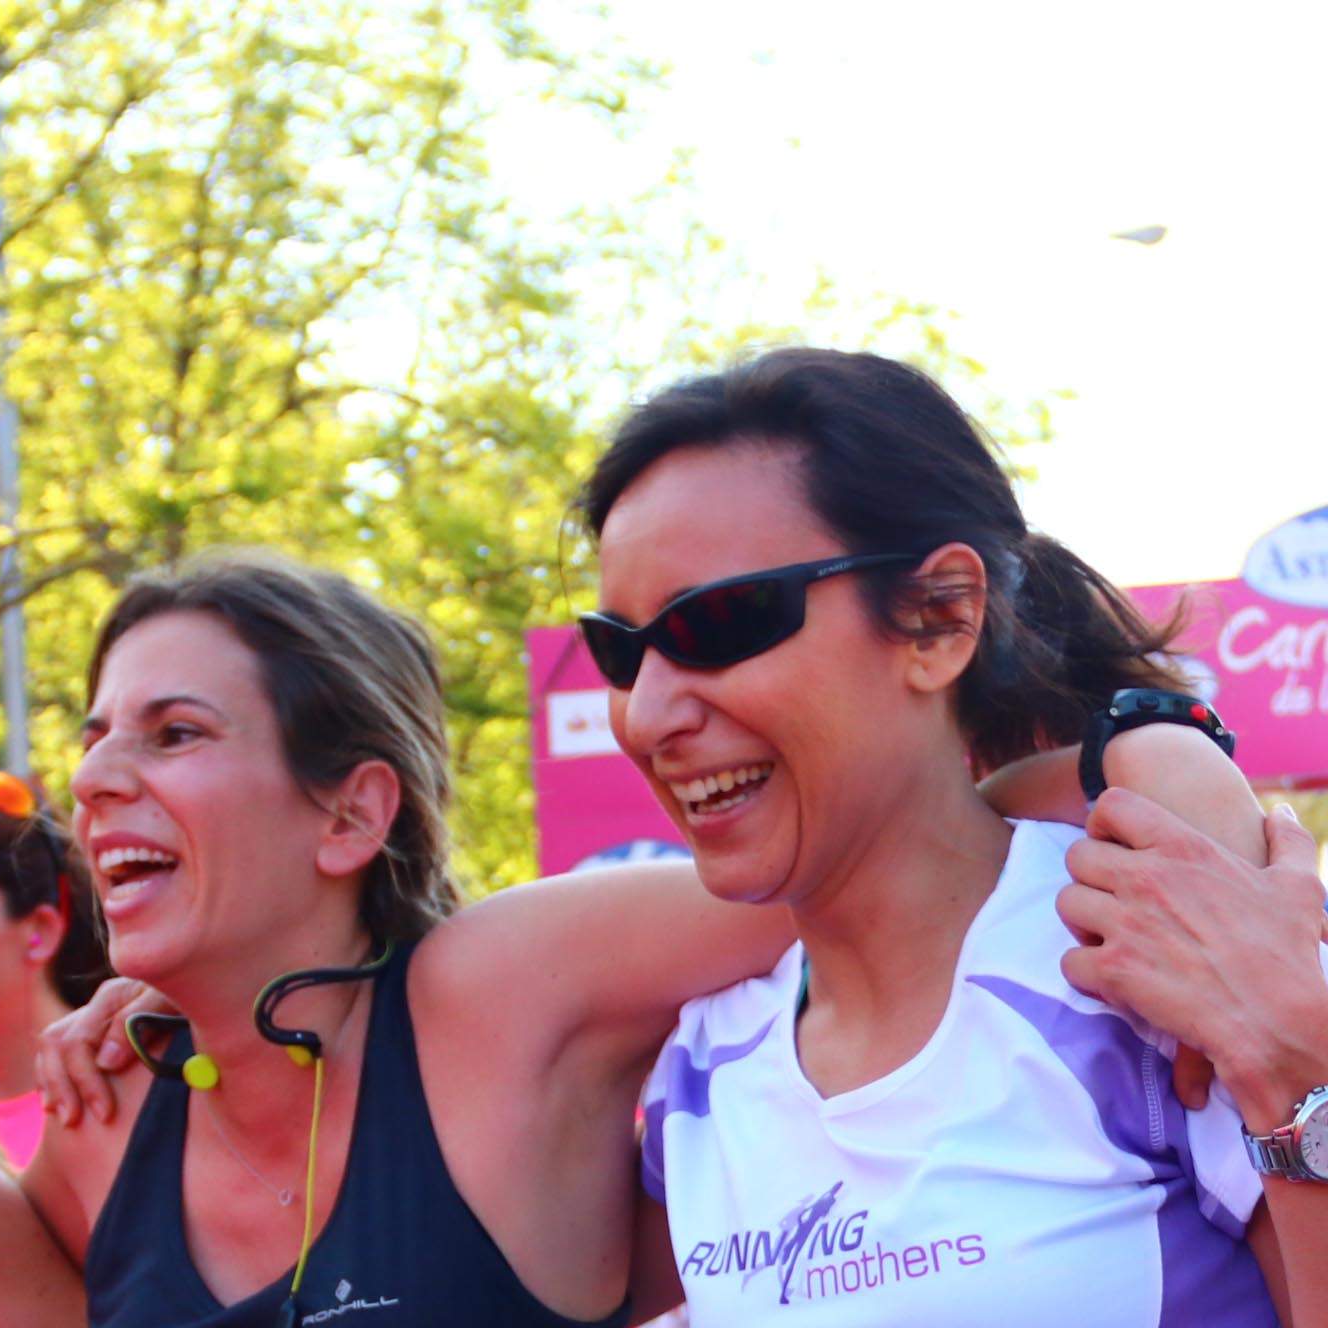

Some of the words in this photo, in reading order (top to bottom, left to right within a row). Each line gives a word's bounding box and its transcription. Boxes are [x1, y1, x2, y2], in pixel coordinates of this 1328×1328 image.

[1272, 671, 1315, 714] de
[806, 1234, 987, 1300] mothers
[301, 1296, 399, 1327] RONHILL
